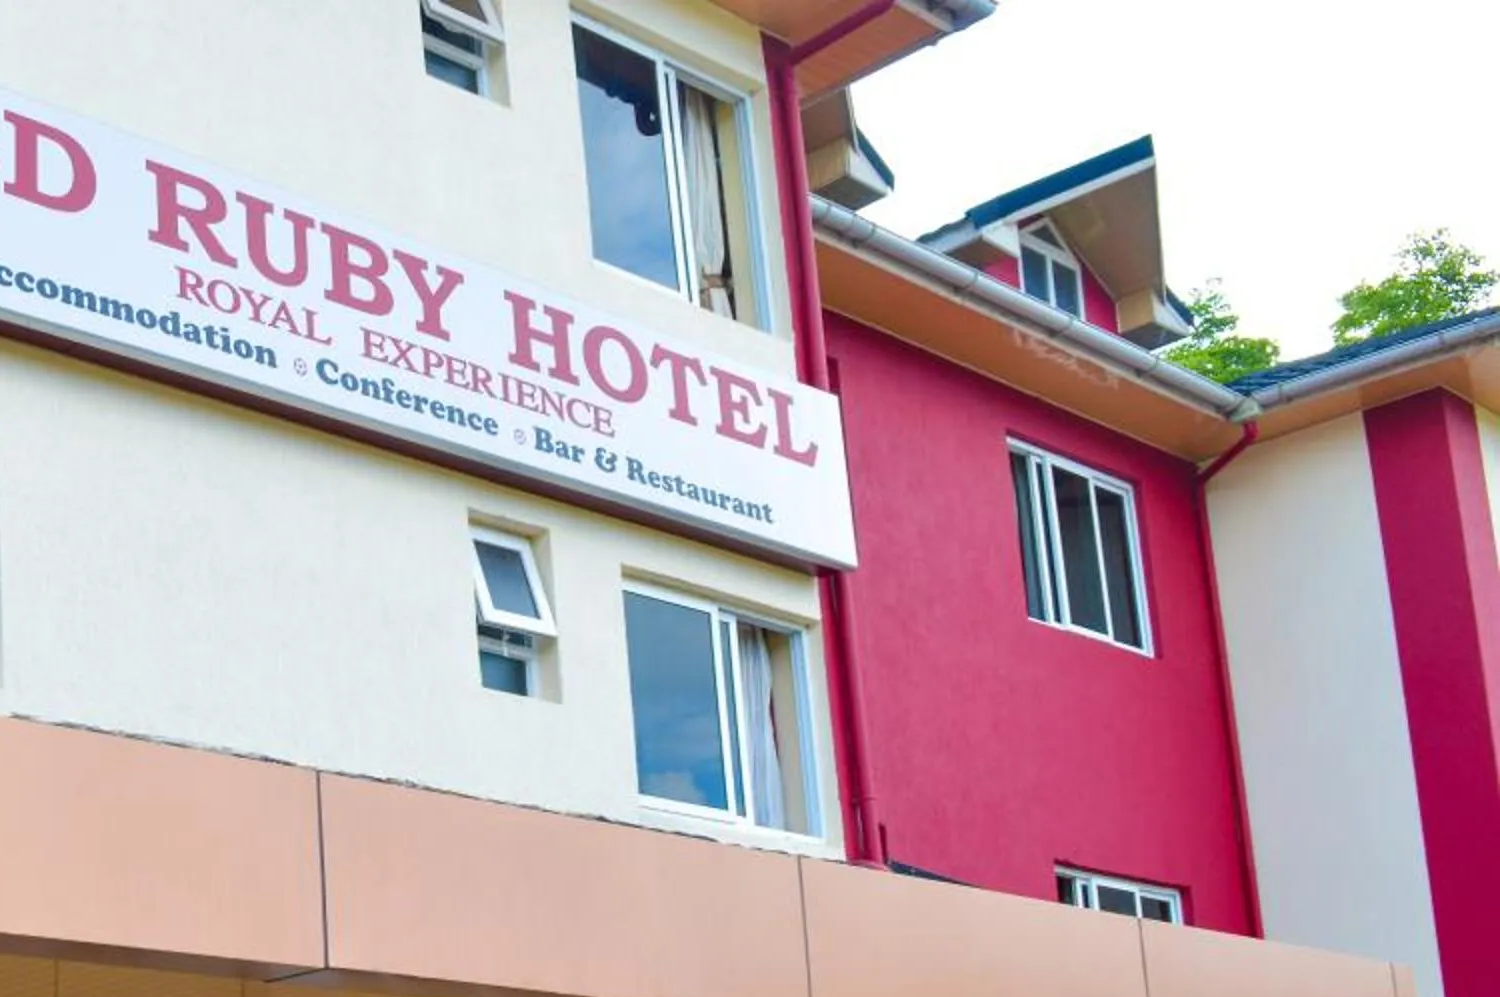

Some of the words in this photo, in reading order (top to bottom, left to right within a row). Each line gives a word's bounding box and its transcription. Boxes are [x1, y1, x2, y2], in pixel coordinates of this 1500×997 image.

[145, 160, 463, 341] RUBY
[503, 290, 818, 467] HOTEL
[177, 267, 333, 346] ROYAL
[360, 328, 616, 437] EXPERIENCE
[315, 359, 500, 436] Conference
[533, 427, 586, 465] Bar
[594, 445, 618, 474] &
[626, 457, 775, 525] Restaurant
